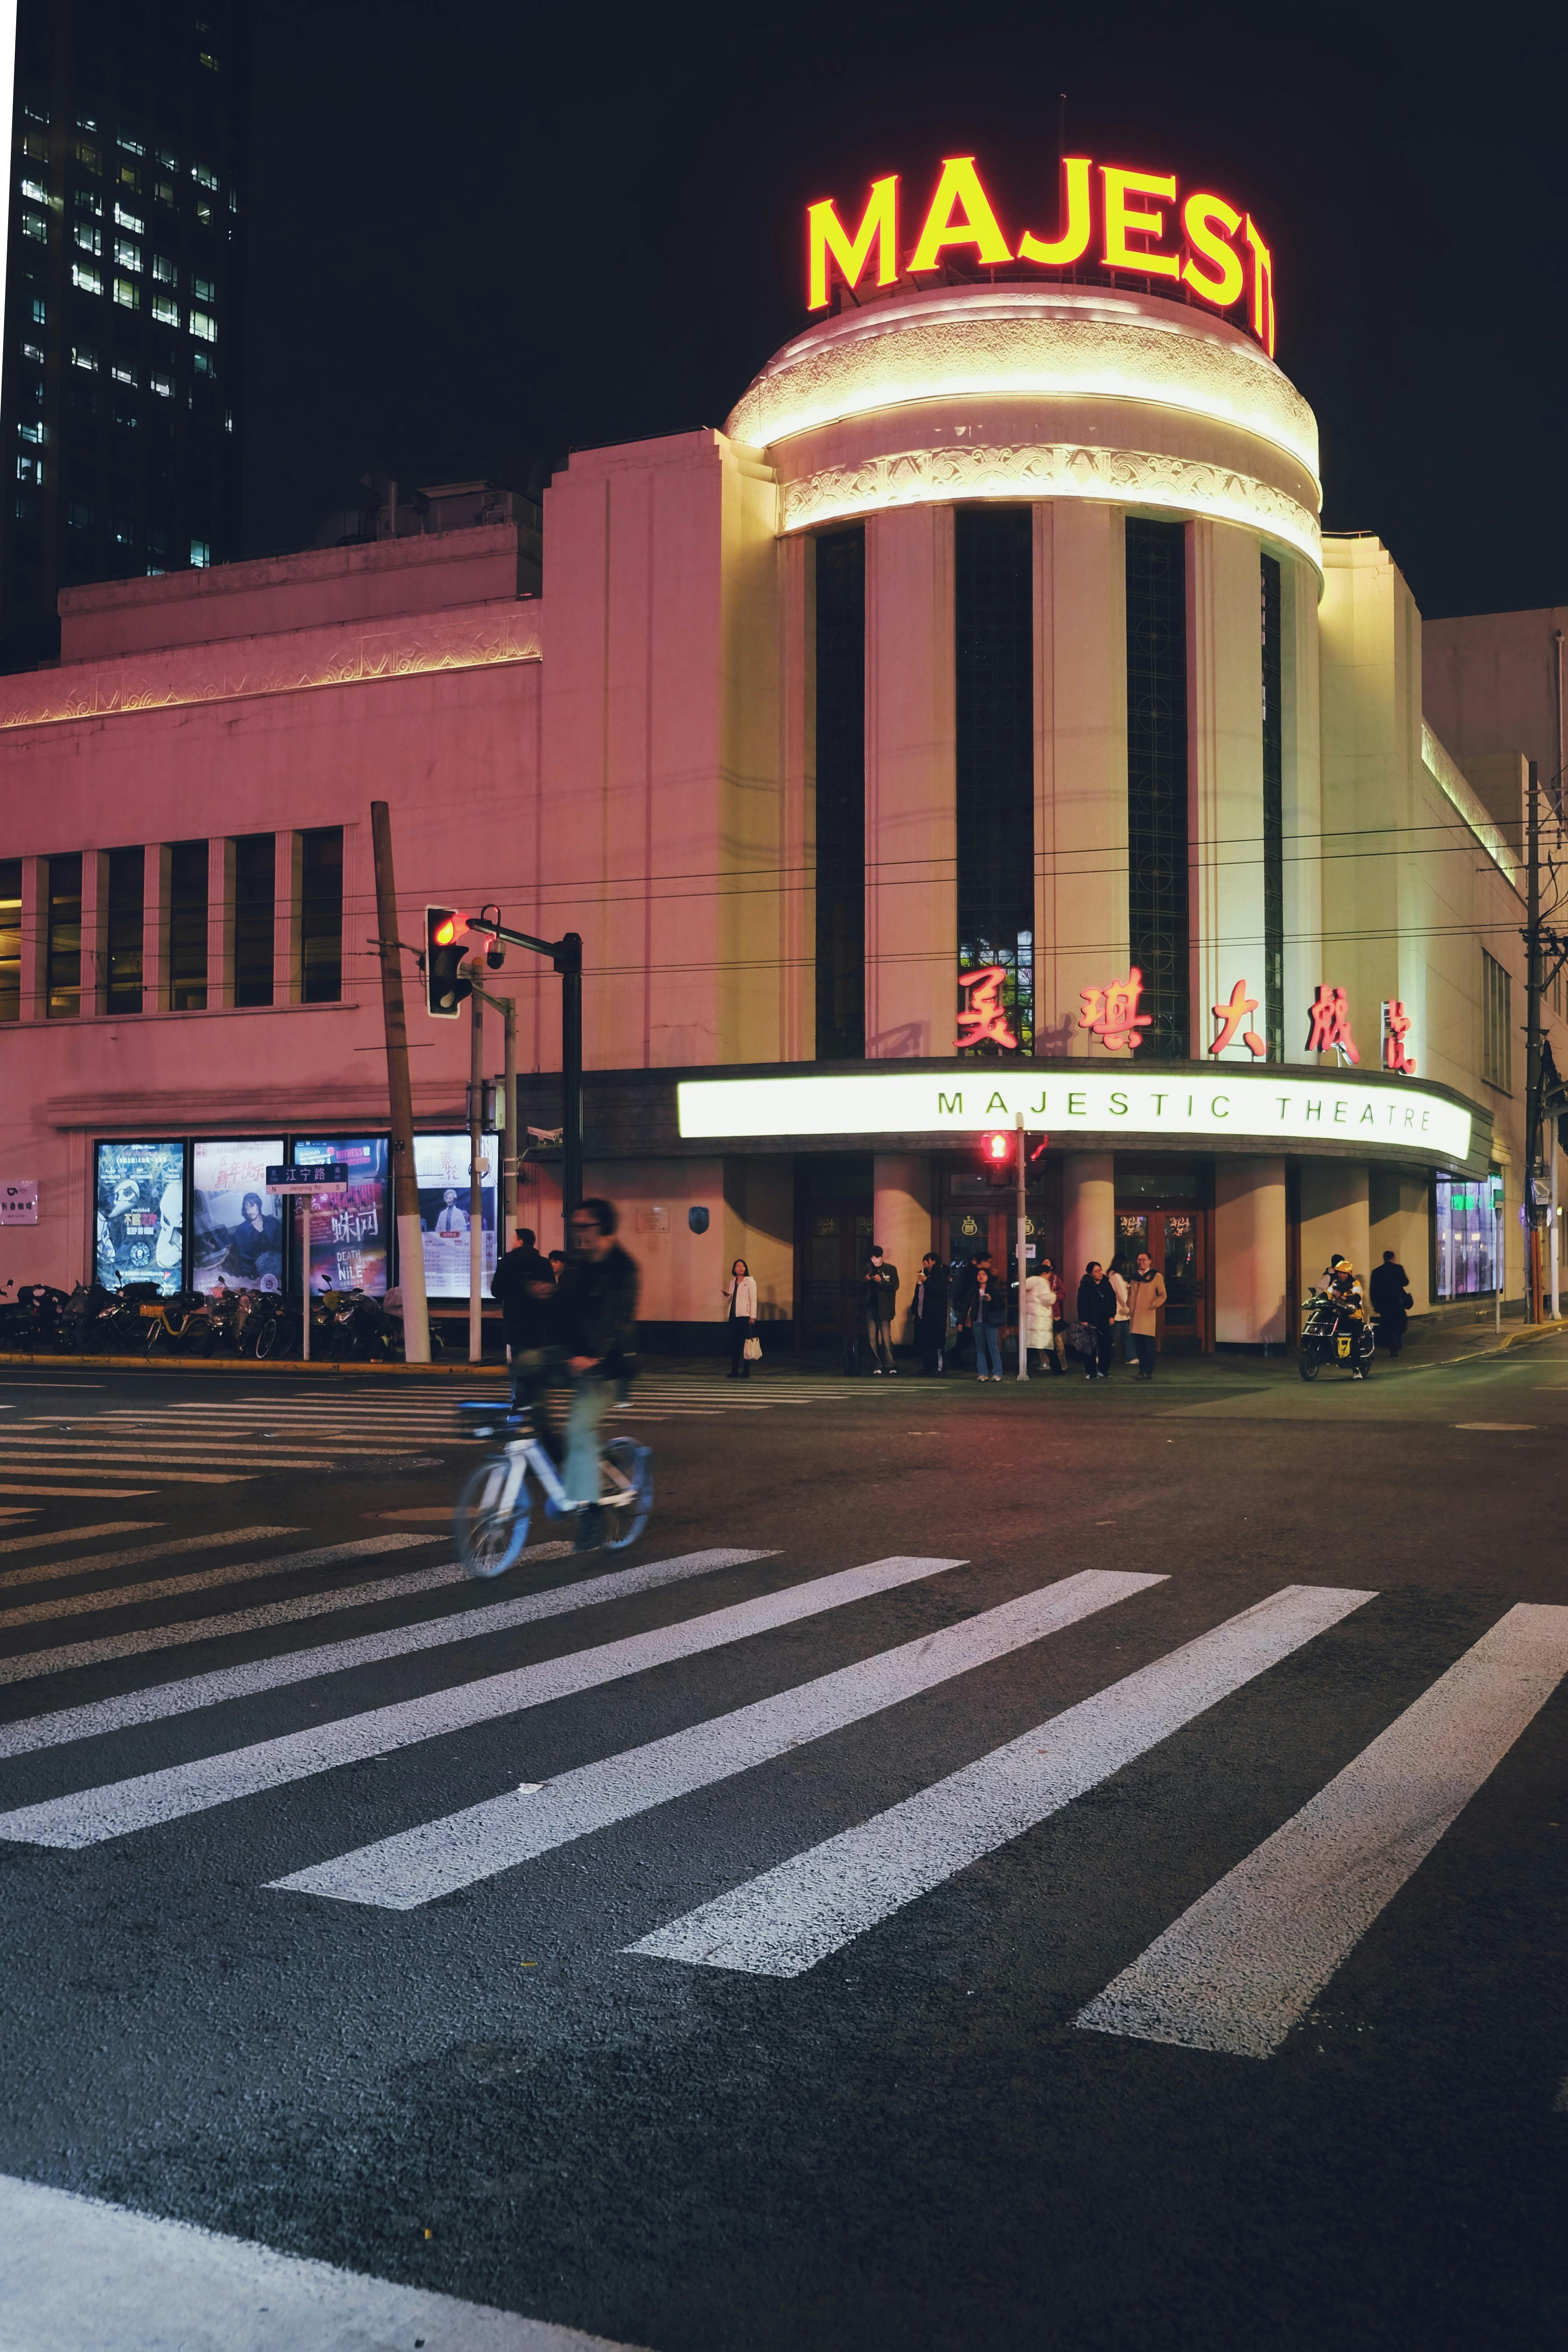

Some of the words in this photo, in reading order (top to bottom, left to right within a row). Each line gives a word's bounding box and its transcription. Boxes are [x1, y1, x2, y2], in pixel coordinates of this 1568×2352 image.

[938, 1091, 1230, 1118] MAJESTIC
[1275, 1097, 1430, 1131] THEATRE
[286, 1168, 326, 1182] 江宁路
[331, 1201, 378, 1244] 蛛网
[337, 1249, 361, 1264] DEATH
[337, 1263, 363, 1281] NILE
